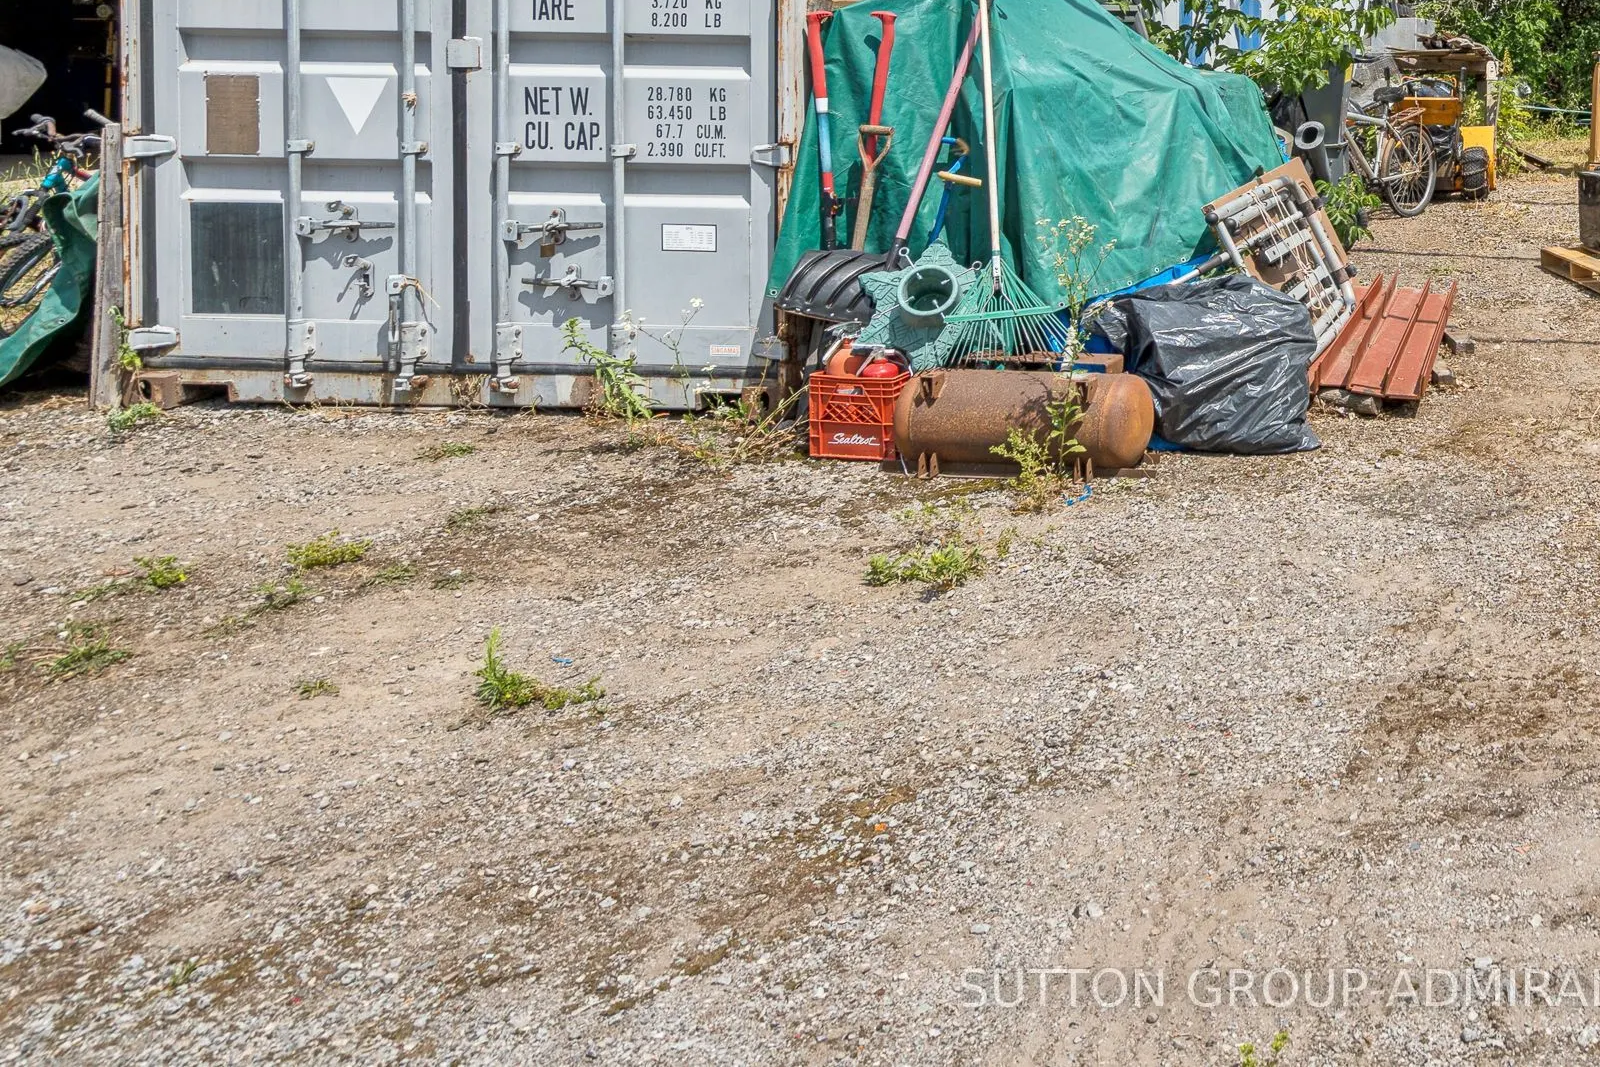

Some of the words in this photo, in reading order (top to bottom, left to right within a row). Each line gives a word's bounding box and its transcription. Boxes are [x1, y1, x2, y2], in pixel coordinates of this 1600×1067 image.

[704, 13, 722, 28] LB
[524, 86, 563, 116] NET
[569, 86, 593, 117] W.
[709, 87, 726, 103] KG
[709, 105, 727, 121] LB
[524, 120, 554, 151] CU.
[563, 121, 603, 152] CAP.
[655, 123, 683, 139] 67.7
[696, 124, 727, 140] CU.M.
[694, 142, 726, 158] CU.FT.
[828, 432, 880, 446] Sealtest
